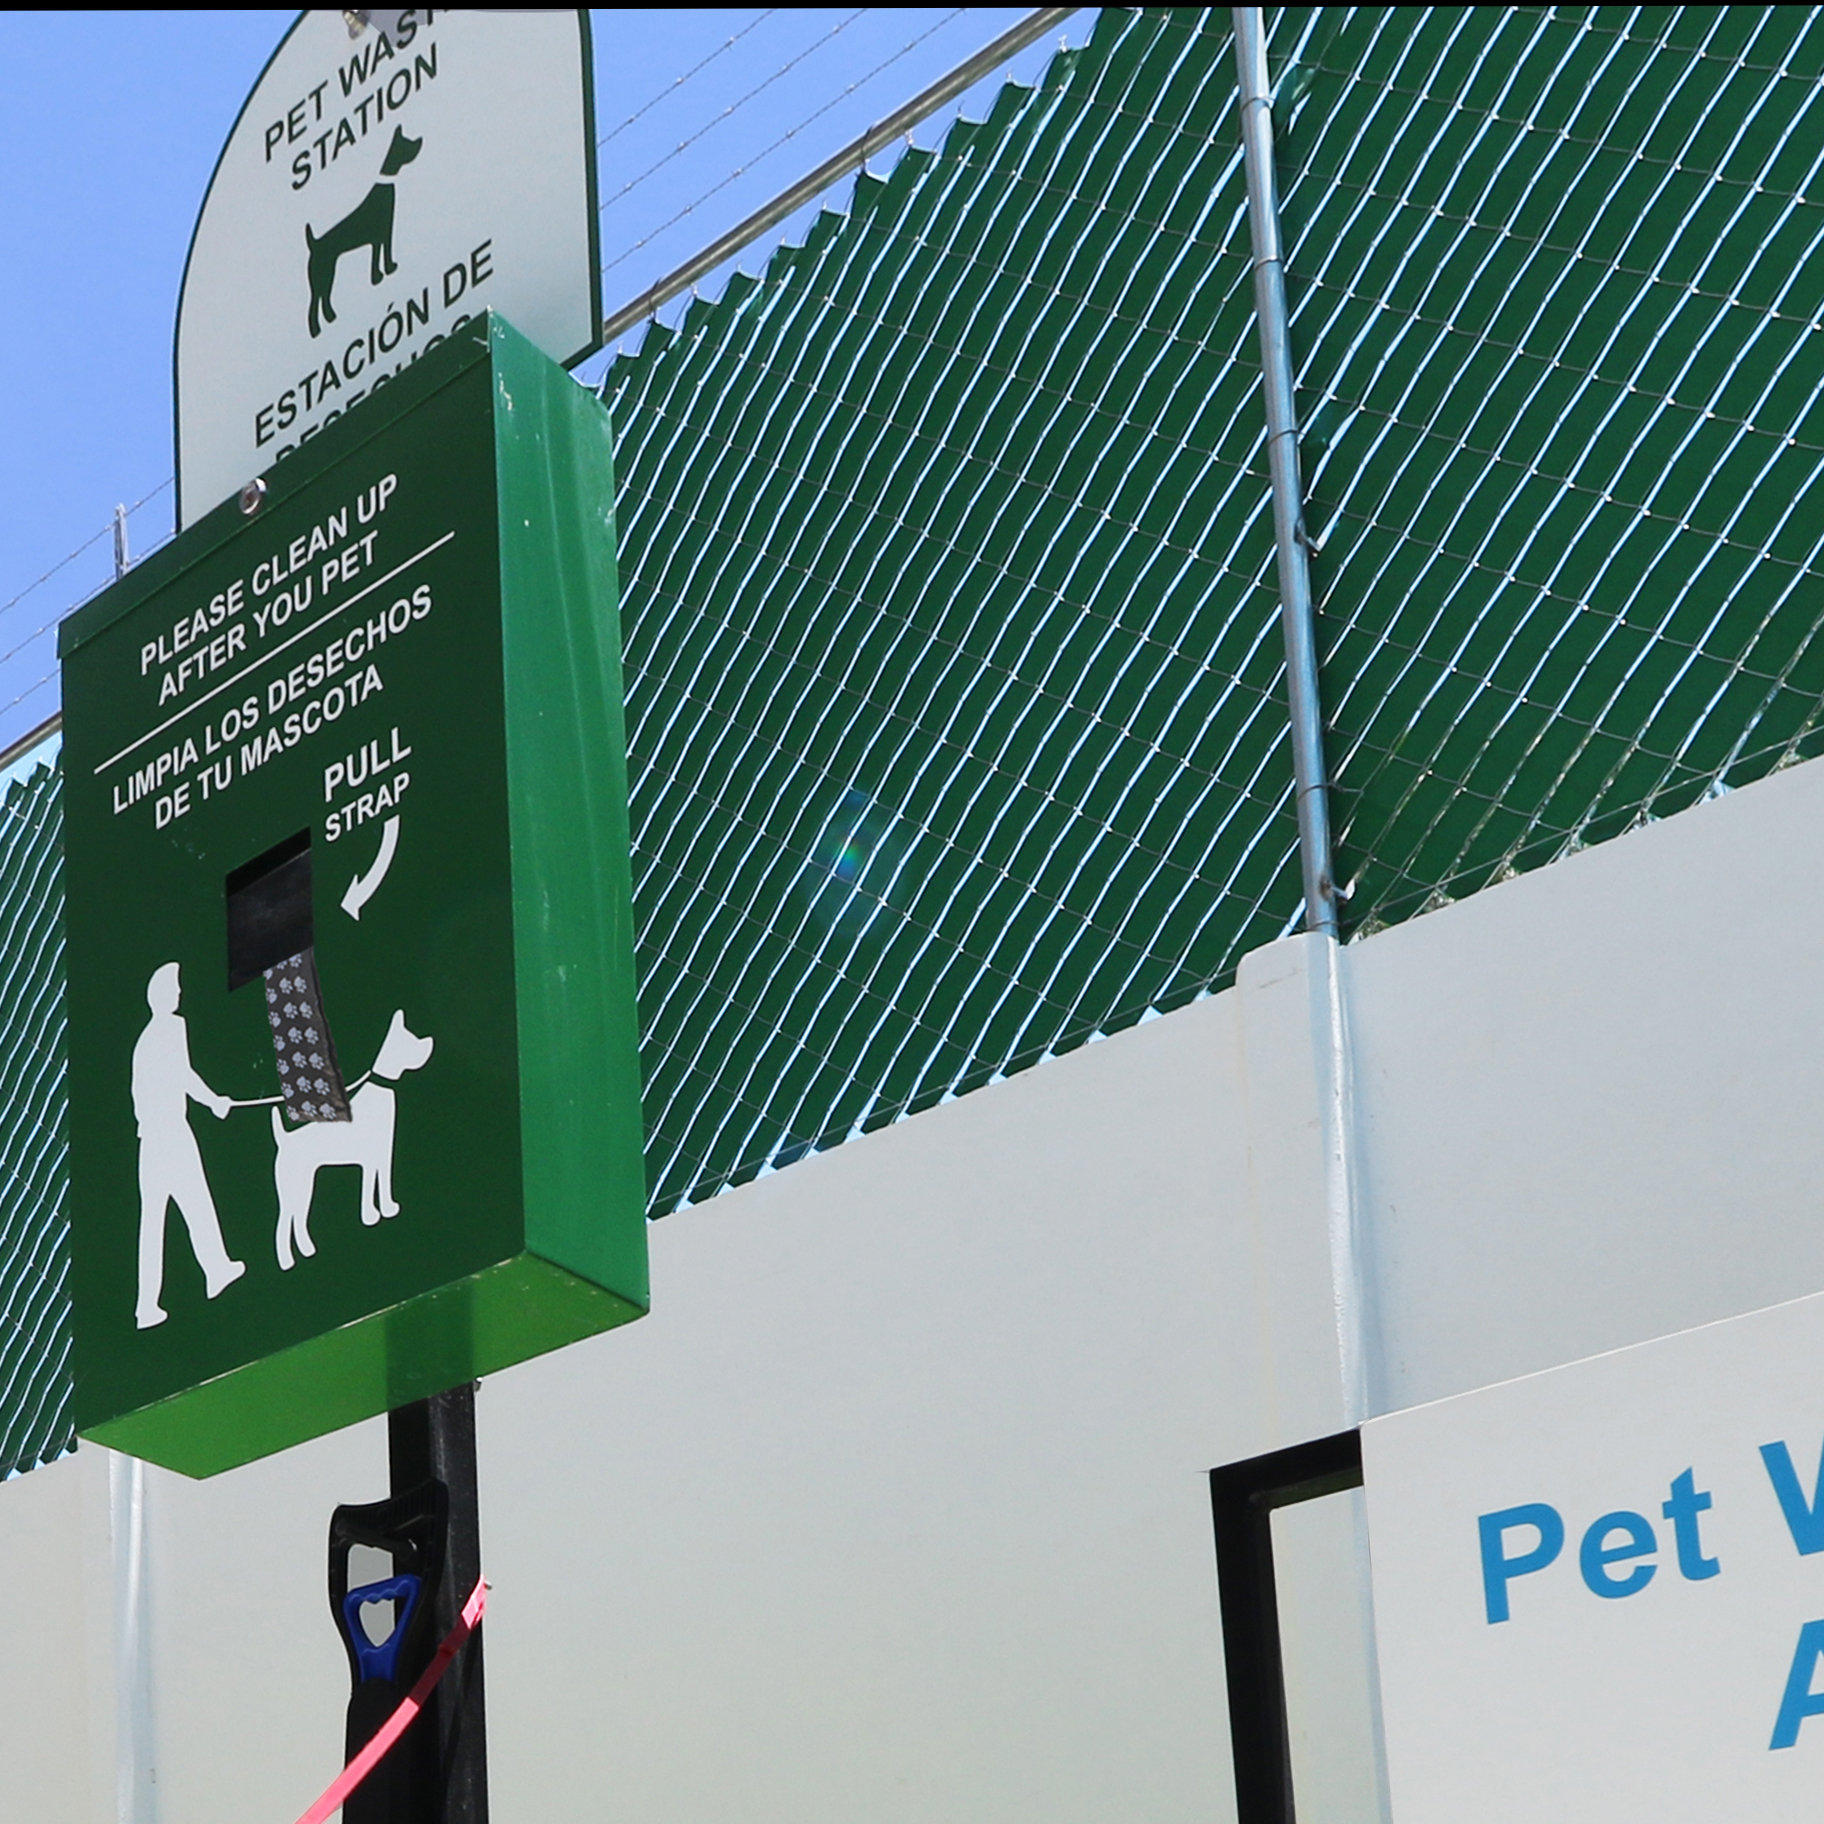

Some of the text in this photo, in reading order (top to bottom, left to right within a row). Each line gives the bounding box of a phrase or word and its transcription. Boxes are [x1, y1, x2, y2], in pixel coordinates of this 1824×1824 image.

[265, 9, 451, 163] PET WAS
[291, 42, 437, 191] STATION
[255, 287, 429, 448] ESTACIÓN
[443, 238, 494, 309] DE
[141, 473, 397, 676] PLEASE CLEAN UP
[158, 529, 378, 706] AFTER YOU PET
[113, 584, 432, 815] LIMPIA LOS DESECHOS
[155, 663, 384, 830] DE TU MASCOTA
[324, 726, 412, 803] PULL
[325, 772, 411, 842] STRAP
[1476, 1467, 1721, 1625] Pet
